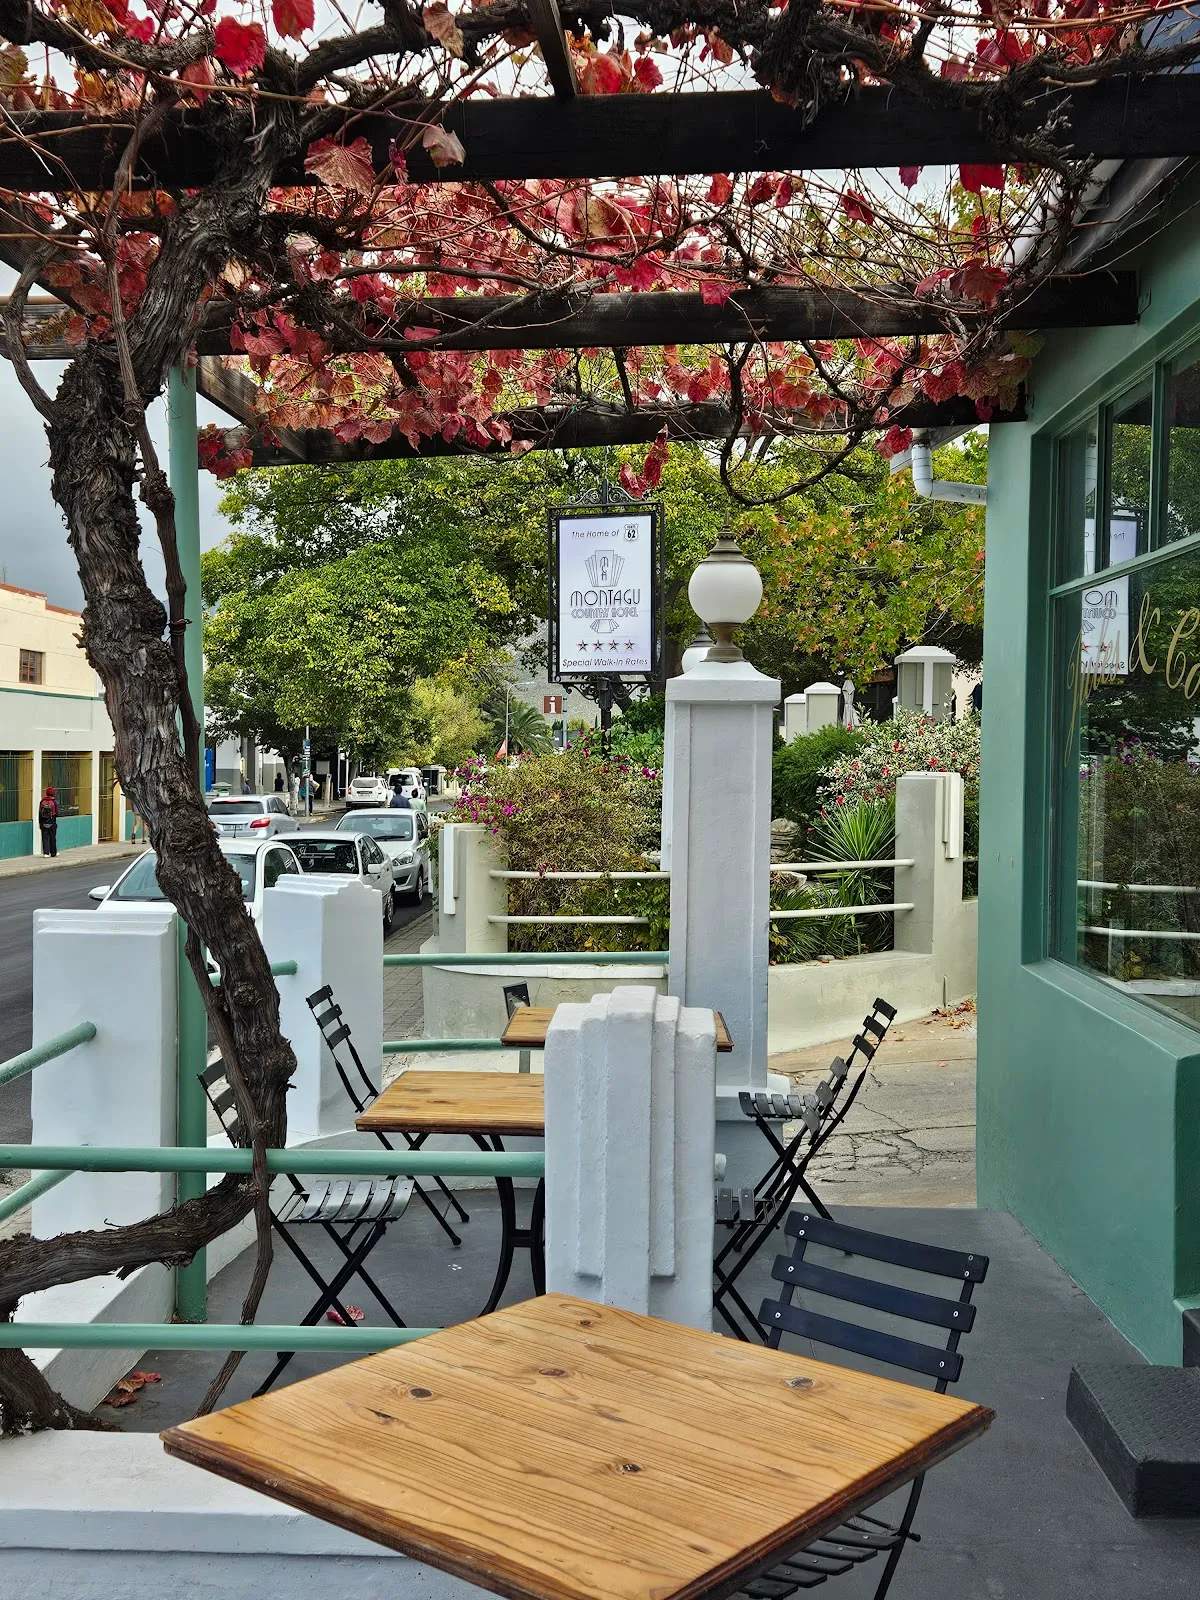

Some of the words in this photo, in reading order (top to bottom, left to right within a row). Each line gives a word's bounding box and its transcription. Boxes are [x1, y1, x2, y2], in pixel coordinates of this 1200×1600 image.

[571, 530, 585, 538] The
[586, 530, 609, 538] Home
[611, 529, 620, 537] of
[627, 529, 636, 539] 62
[570, 588, 641, 607] MONTAGU
[570, 607, 609, 619] COUNTRY
[611, 606, 639, 618] HOTEL
[562, 658, 592, 668] Special
[625, 657, 648, 666] Rates
